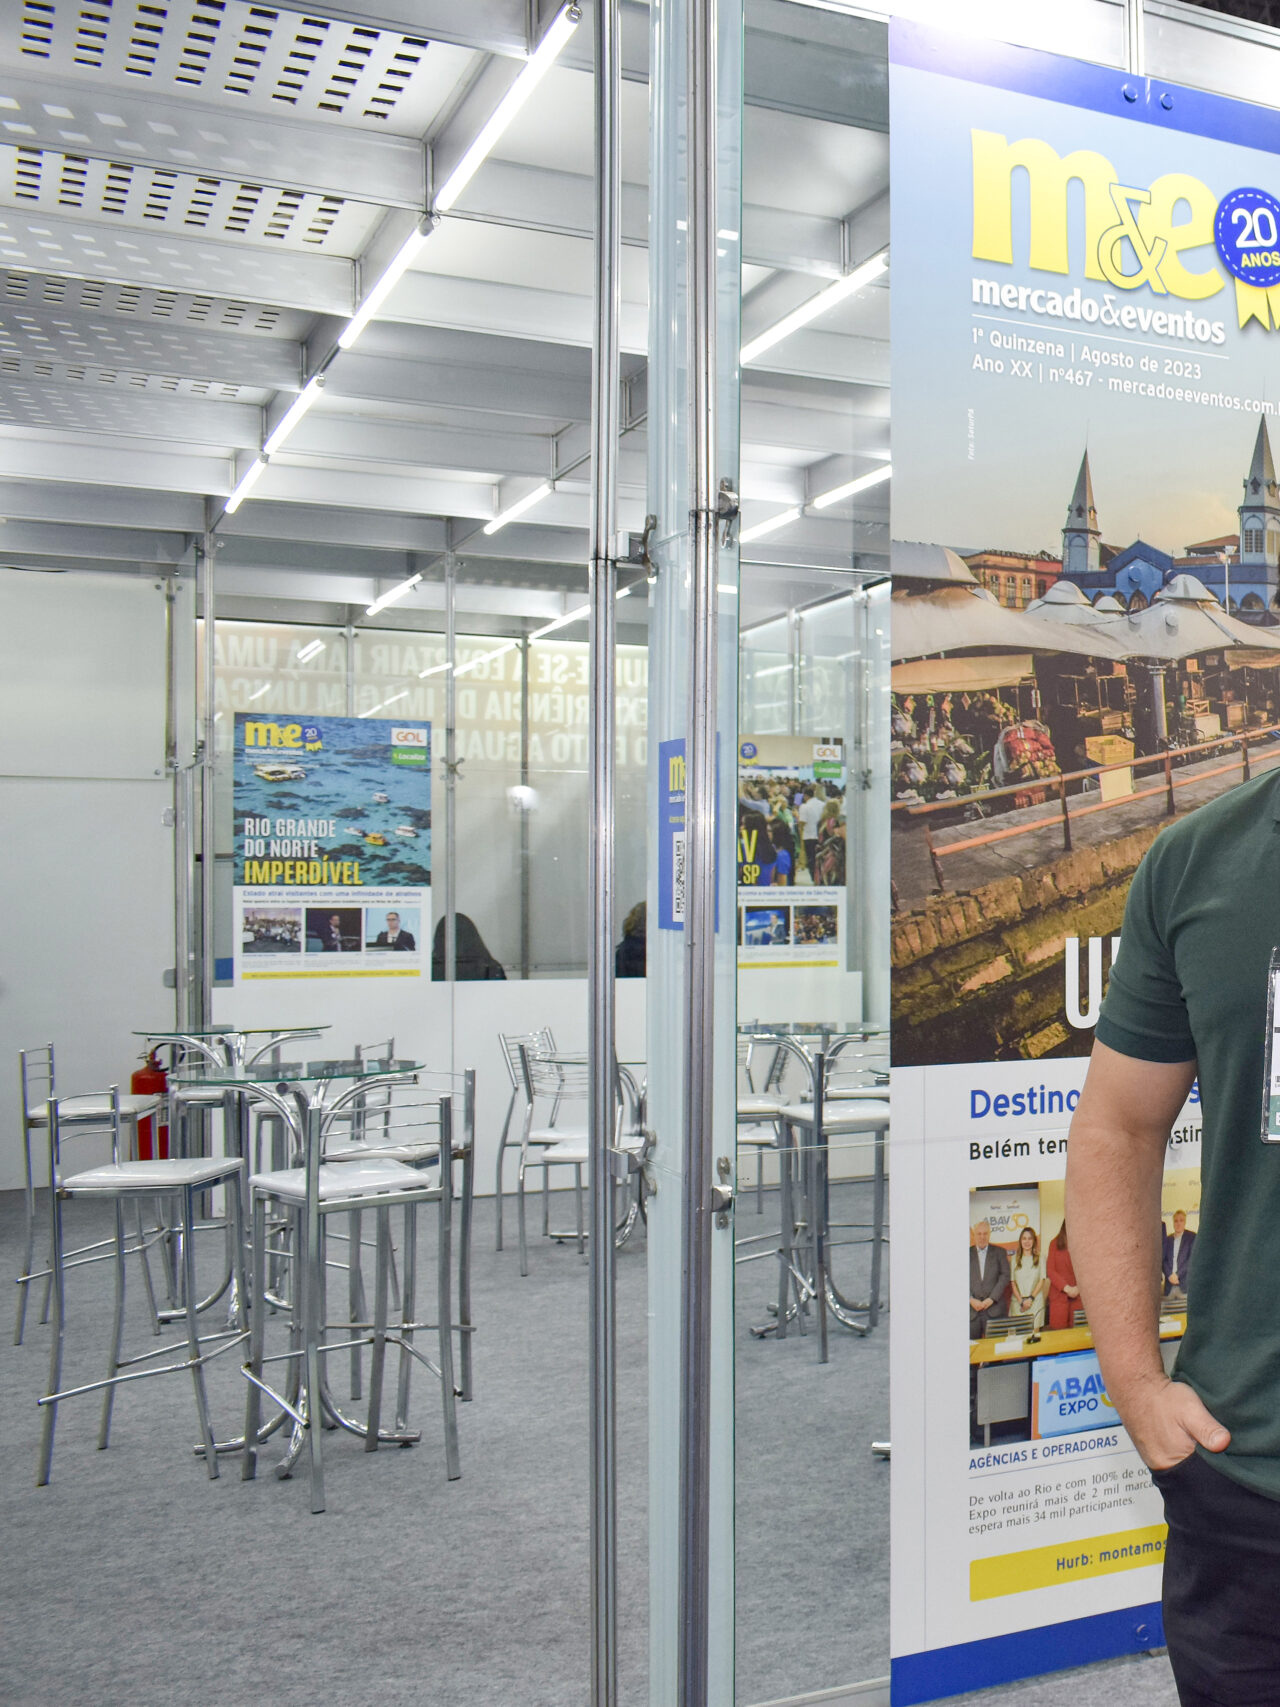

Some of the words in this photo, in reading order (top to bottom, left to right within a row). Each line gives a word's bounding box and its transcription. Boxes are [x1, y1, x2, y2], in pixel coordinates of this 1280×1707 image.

[971, 128, 1225, 300] m&e
[1231, 207, 1278, 248] 20
[972, 277, 1226, 345] mercado&eventos
[972, 354, 1004, 373] Ano
[1010, 358, 1033, 378] XX
[989, 331, 1065, 358] Quinzena
[1081, 346, 1134, 369] Agosto
[1140, 354, 1159, 373] de
[1164, 359, 1202, 380] 2023
[245, 722, 303, 748] m&e
[304, 728, 317, 738] 20
[396, 731, 424, 743] GOL
[244, 818, 270, 837] RIO
[275, 819, 336, 838] GRANDE
[244, 838, 265, 857] DO
[270, 839, 319, 858] NORTE
[244, 854, 363, 885] IMPERDÍVEL
[743, 864, 760, 884] SP
[970, 1138, 1030, 1160] Belém
[1059, 1398, 1098, 1416] EXPO
[968, 1450, 1028, 1471] AGÊNCIAS
[1031, 1448, 1038, 1460] E
[1042, 1435, 1119, 1458] OPERADORAS
[969, 1495, 984, 1507] De
[988, 1490, 1014, 1503] volta
[1018, 1489, 1031, 1498] ao
[1035, 1483, 1052, 1495] Rio
[1056, 1483, 1062, 1491] e
[1065, 1479, 1087, 1490] com
[1092, 1471, 1118, 1485] 100%
[1122, 1468, 1134, 1479] de
[969, 1507, 997, 1521] Expo
[1002, 1501, 1039, 1515] reunirá
[1044, 1494, 1068, 1506] mais
[1073, 1490, 1086, 1501] de
[1091, 1488, 1098, 1498] 2
[1104, 1485, 1119, 1496] mil
[969, 1521, 1003, 1535] espera
[1007, 1516, 1031, 1528] mais
[1033, 1511, 1046, 1522] 34
[1050, 1506, 1066, 1519] mil
[1069, 1497, 1136, 1518] participantes.
[1056, 1552, 1094, 1571] Hurb:
